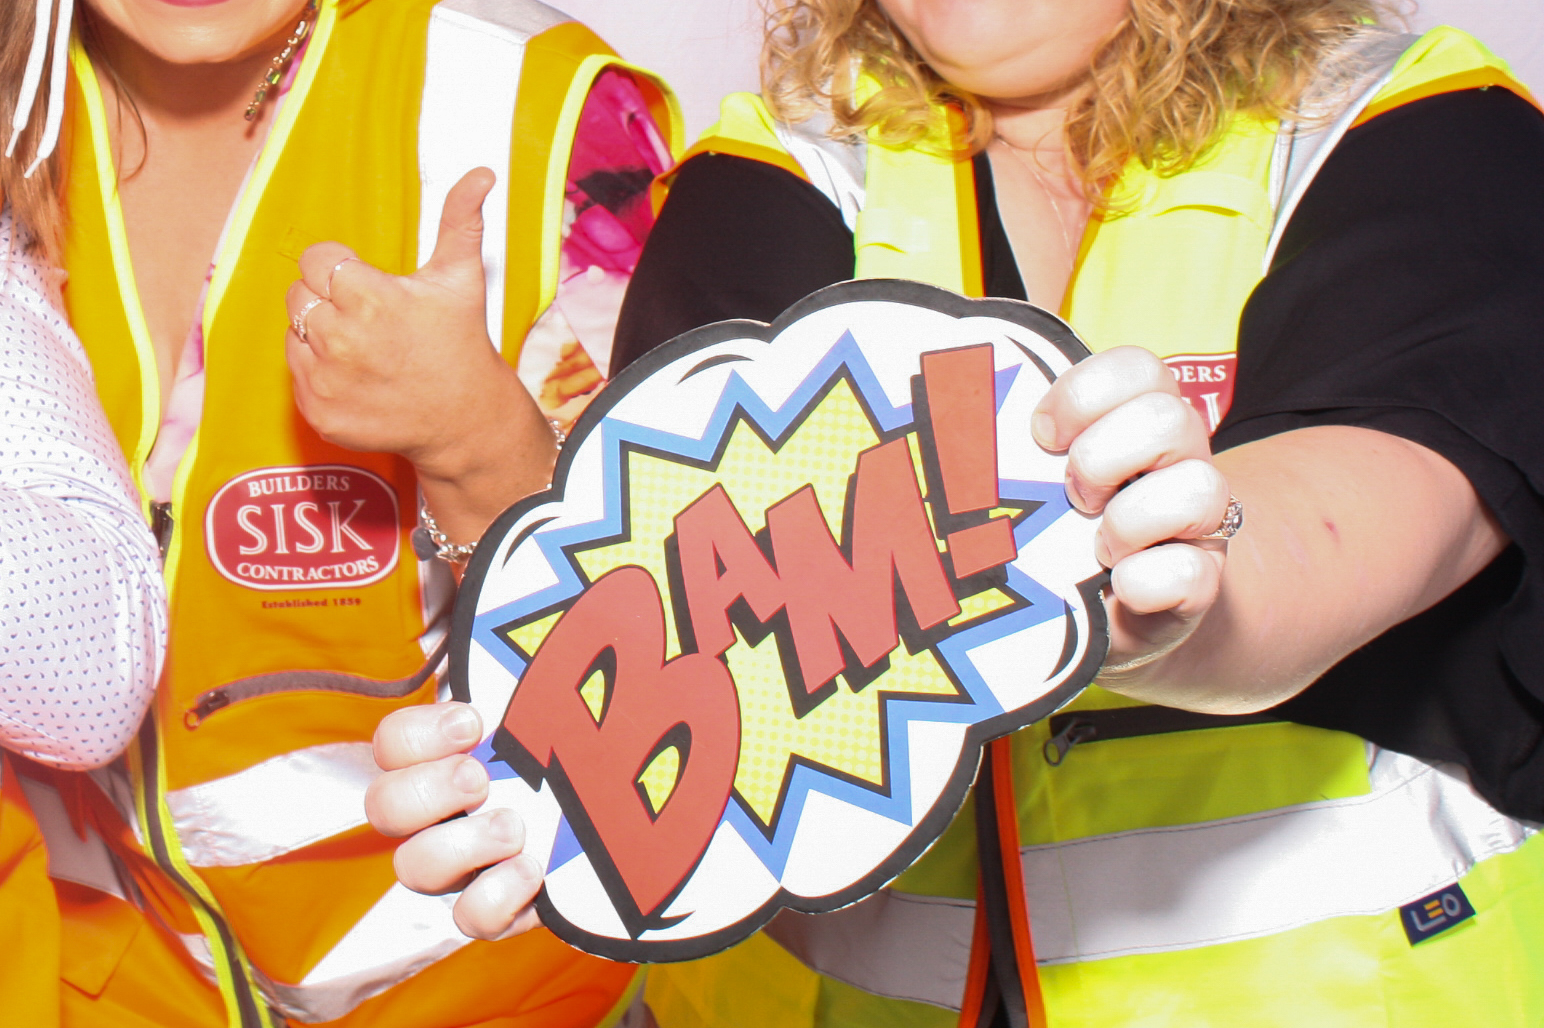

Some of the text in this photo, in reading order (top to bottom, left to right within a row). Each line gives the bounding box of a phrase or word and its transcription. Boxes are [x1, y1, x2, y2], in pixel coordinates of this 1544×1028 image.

[248, 475, 350, 498] BUILDERS
[236, 499, 374, 556] SISK
[236, 556, 380, 582] CONTRACTORS
[261, 598, 328, 609] Established
[496, 342, 1018, 927] BAM!
[1410, 893, 1462, 932] LEO
